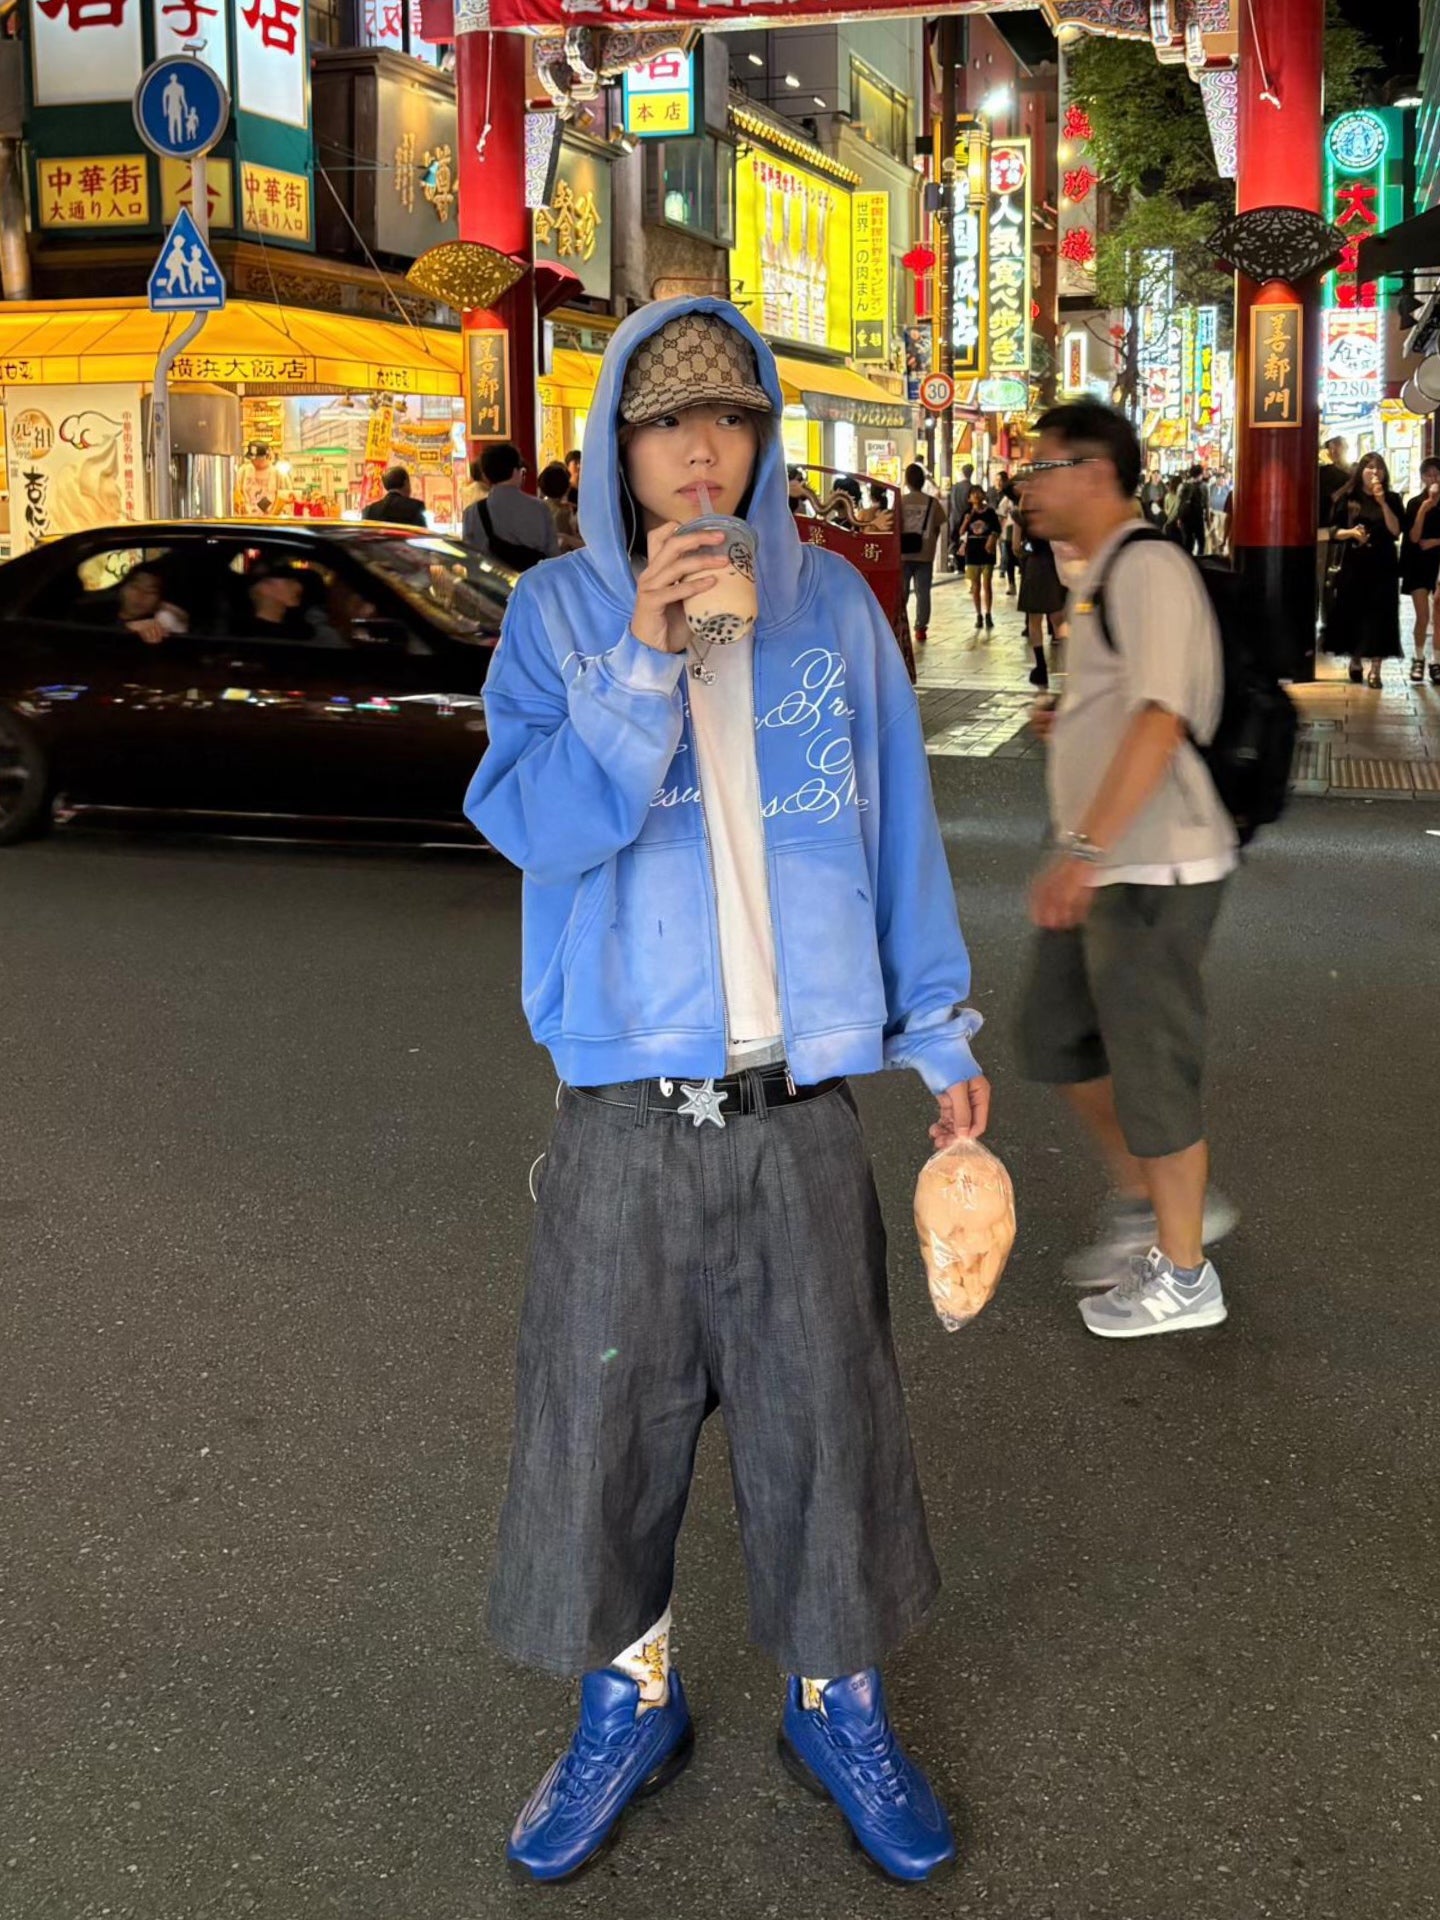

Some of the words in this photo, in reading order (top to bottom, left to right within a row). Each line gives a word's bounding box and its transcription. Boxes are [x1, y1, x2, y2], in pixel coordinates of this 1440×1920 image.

[637, 101, 681, 122] 本店
[48, 164, 142, 197] 中華街
[245, 172, 302, 213] 中華街
[49, 199, 142, 221] 大通り入口
[246, 208, 303, 231] 大通り入口
[856, 201, 870, 313] 世界一の肉まん
[171, 358, 307, 380] 横浜大飯店
[928, 383, 948, 400] 30
